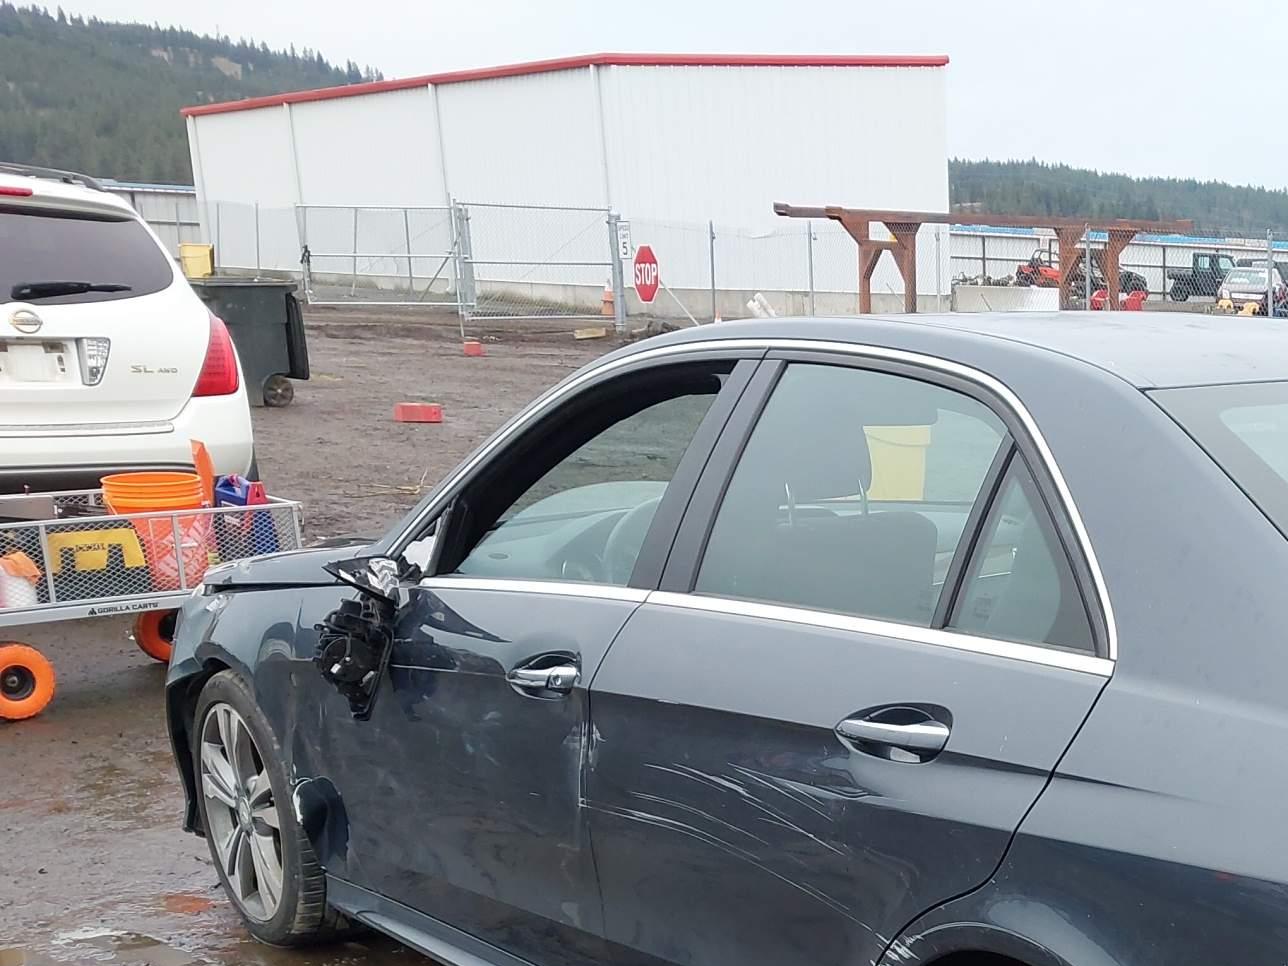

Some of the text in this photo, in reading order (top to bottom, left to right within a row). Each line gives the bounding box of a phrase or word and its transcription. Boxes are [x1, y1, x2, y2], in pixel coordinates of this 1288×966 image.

[622, 242, 629, 256] 5
[635, 263, 658, 285] STOP
[131, 365, 154, 374] SL
[97, 605, 130, 614] GORILLA
